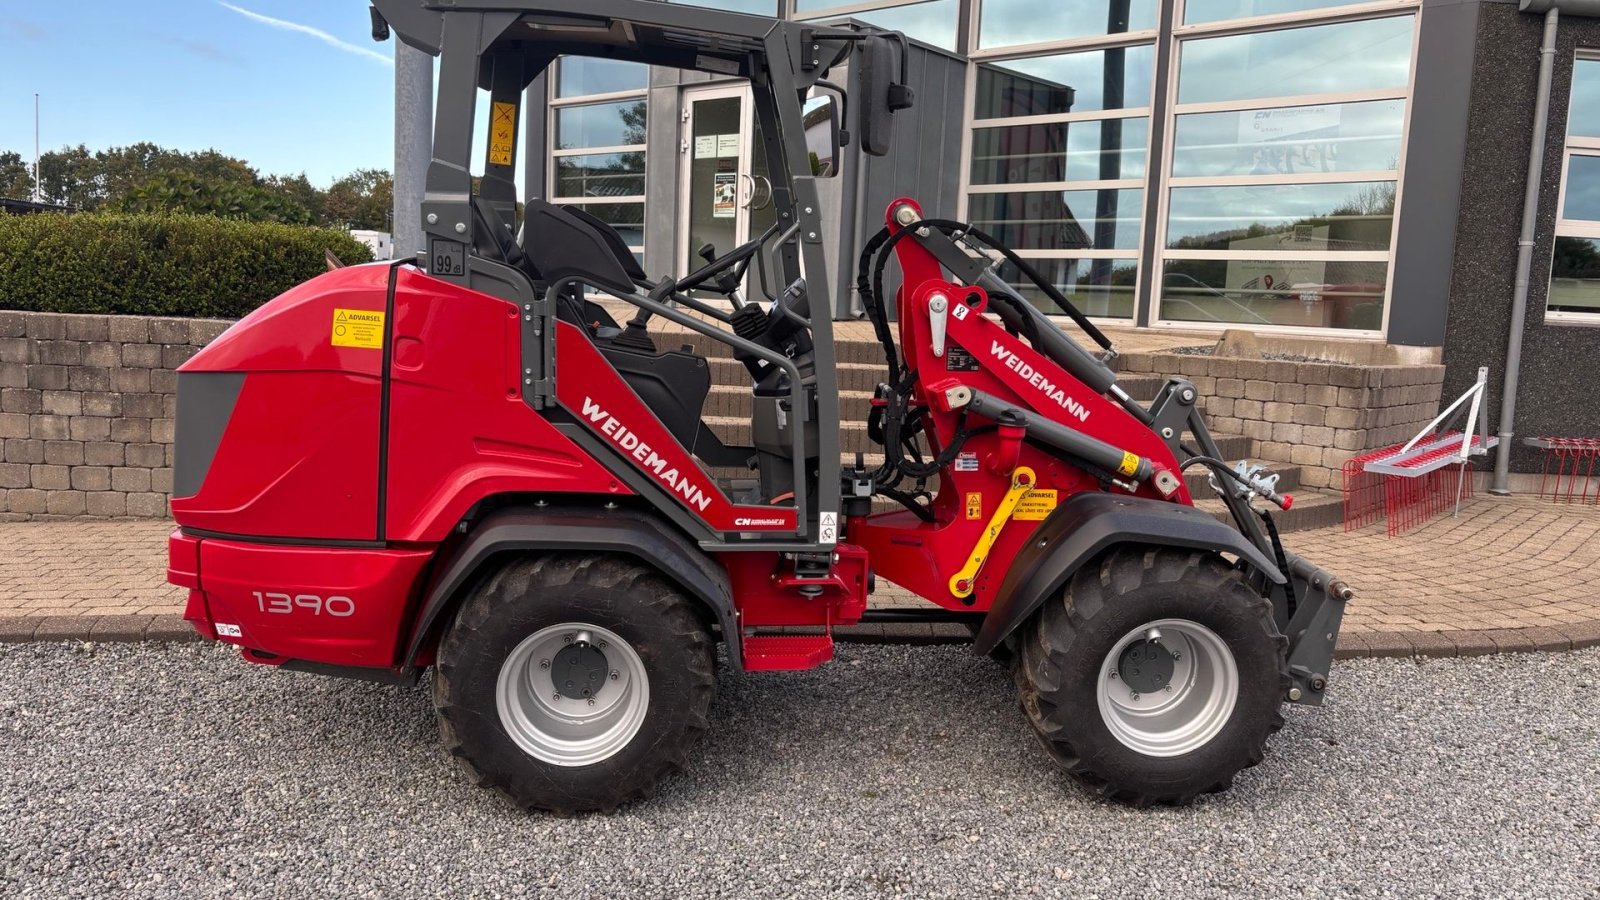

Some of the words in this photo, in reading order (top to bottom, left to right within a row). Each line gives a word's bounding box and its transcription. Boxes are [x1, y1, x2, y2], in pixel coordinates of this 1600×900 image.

[437, 255, 452, 273] 99
[348, 314, 381, 322] ADVARSEL
[992, 340, 1090, 422] WEIDEMANN
[581, 395, 713, 512] WEIDEMANN
[734, 518, 752, 526] CN
[252, 591, 356, 617] 1390
